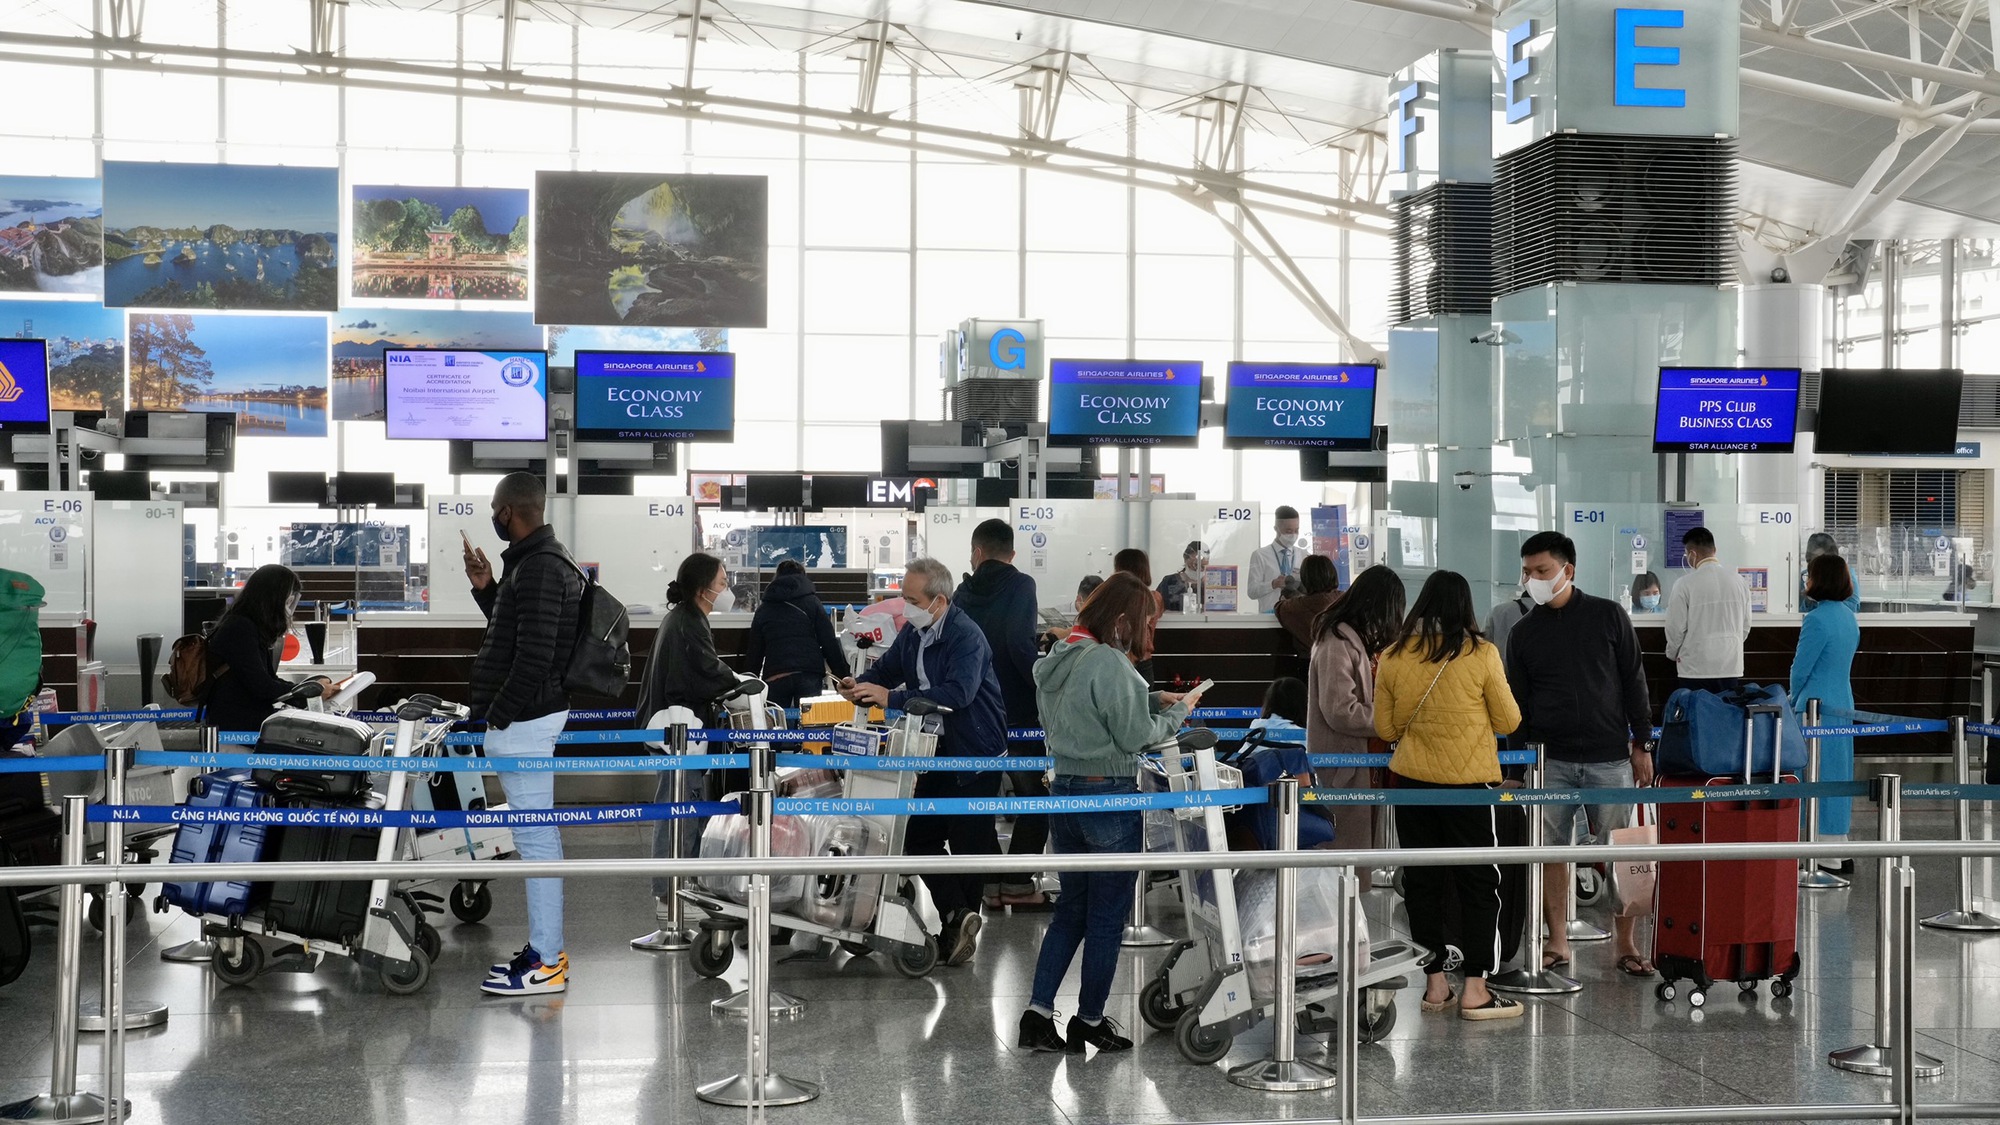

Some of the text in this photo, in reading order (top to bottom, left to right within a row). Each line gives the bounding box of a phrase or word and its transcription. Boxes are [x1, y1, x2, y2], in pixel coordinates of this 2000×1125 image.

[1614, 8, 1686, 107] E
[1506, 19, 1534, 125] E
[1399, 81, 1418, 173] F
[988, 327, 1026, 371] G
[389, 354, 412, 363] NIA
[655, 363, 695, 371] AIRLINES
[607, 387, 703, 403] ECONOMY
[1080, 394, 1170, 409] ECONOMY
[626, 403, 684, 419] CLASS
[1256, 397, 1345, 412] ECONOMY
[1699, 400, 1756, 413] PPS CLUB
[1097, 410, 1152, 425] CLASS
[1273, 412, 1326, 427] CLASS
[1679, 416, 1773, 428] BUSINESS CLASS
[1956, 446, 1974, 454] office
[44, 499, 83, 513] E-06
[437, 502, 474, 516] E-05
[648, 503, 685, 517] E-04
[1019, 506, 1054, 520] E-03
[1217, 507, 1251, 521] E-02
[1574, 510, 1605, 523] E-01
[1760, 511, 1792, 524] E-00
[34, 517, 56, 525] ACV
[366, 519, 386, 527] ACV
[70, 710, 193, 722] NOIBAI INTERNATIONAL AIRPORT
[568, 710, 636, 719] NATIONAL AIRPORT
[688, 731, 708, 739] N.I.A
[728, 730, 751, 740] CẢNG
[777, 731, 805, 740] KHÔNG
[807, 730, 830, 740] QUỐC
[1022, 730, 1046, 738] AIRPO
[1806, 727, 1860, 736] INTERNATIONAL
[1861, 725, 1890, 733] AIRPORT
[190, 754, 217, 764] N.I.A
[312, 757, 350, 768] KHÔNG
[466, 760, 492, 769] N.I.A
[517, 760, 553, 769] NOIBAI
[555, 759, 636, 769] INTERNATIONAL
[638, 757, 683, 767] AIRPORT
[711, 757, 736, 766] N.I.A
[825, 757, 850, 767] N.I.A
[937, 758, 973, 769] KHÔNG
[1316, 792, 1376, 801] Vietnam Airlines
[1514, 791, 1571, 802] Vietnam Airlines
[1704, 788, 1761, 799] Vietnam Airlines
[1901, 788, 1924, 796] ietnam
[907, 801, 936, 812] N.I.A
[968, 801, 1008, 811] NOIBAI
[1010, 798, 1101, 811] INTERNATIONAL
[1103, 795, 1154, 808] AIRPORT
[1185, 794, 1213, 805] N.I.A
[113, 809, 140, 820] N.I.A
[171, 808, 204, 820] CẢNG
[243, 810, 284, 822] KHÔNG
[287, 810, 320, 823] QUỐC
[323, 810, 338, 823] TẾ
[339, 812, 359, 825] NỘI
[363, 811, 383, 824] BÀI
[410, 814, 436, 824] N.I.A
[466, 813, 503, 824] NOIBAI
[507, 811, 592, 824] INTERNATIONAL
[597, 808, 643, 820] AIRPORT
[671, 805, 697, 816] N.I.A
[375, 897, 384, 907] T2
[1231, 952, 1241, 962] T2
[1227, 991, 1237, 1002] T2
